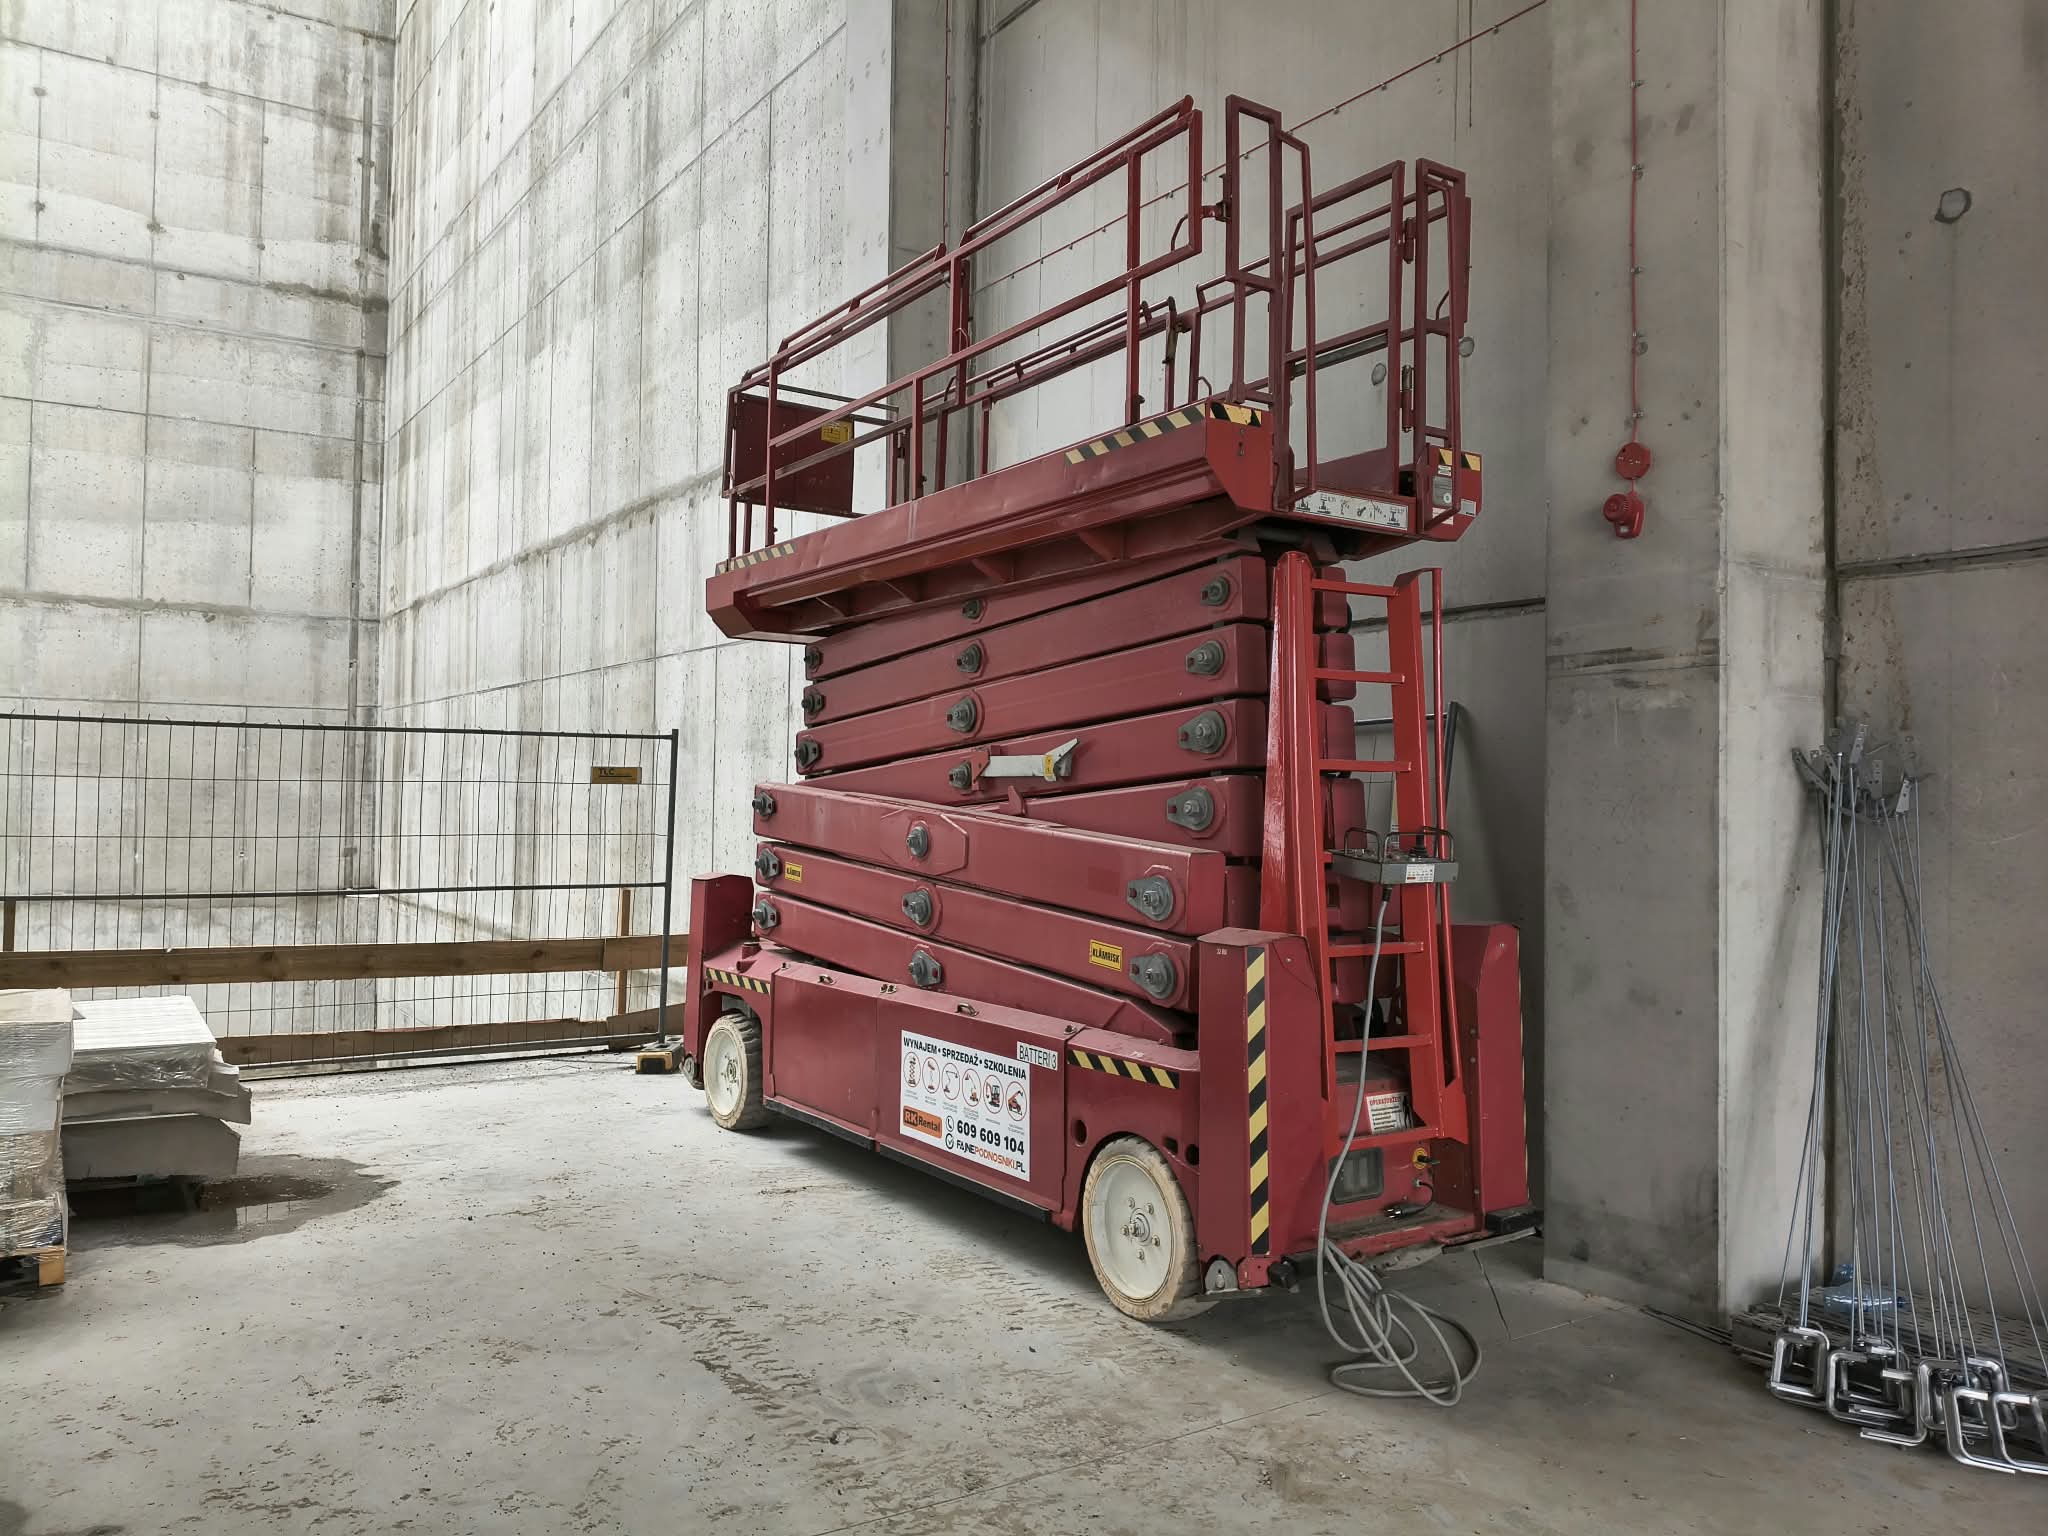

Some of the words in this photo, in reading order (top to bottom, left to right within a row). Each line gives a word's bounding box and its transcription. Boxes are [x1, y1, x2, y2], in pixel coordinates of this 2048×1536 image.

[903, 1036, 937, 1055] WYNAJEM
[942, 1047, 979, 1067] SPRZEDAŻ
[983, 1058, 1027, 1081] SZKOLENIA
[919, 1116, 941, 1132] Rental
[957, 1119, 977, 1139] 609
[980, 1127, 1001, 1147] 609
[1003, 1135, 1025, 1156] 104
